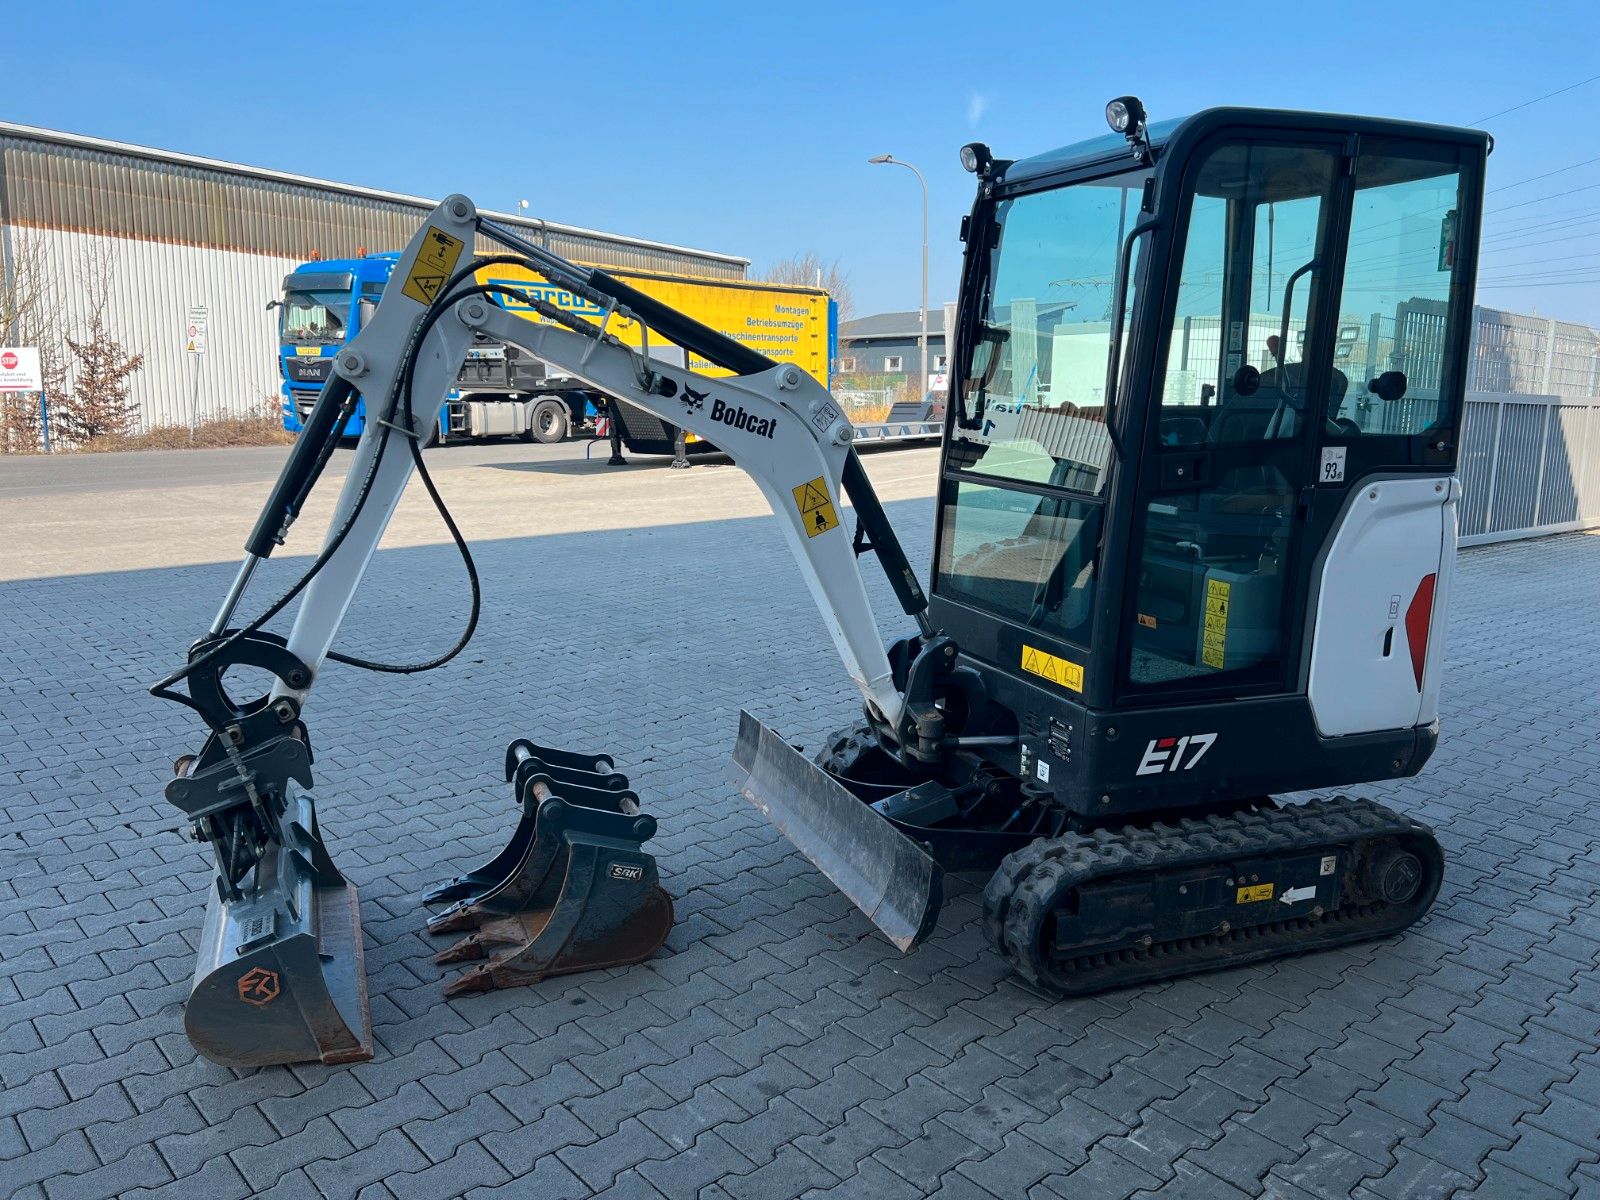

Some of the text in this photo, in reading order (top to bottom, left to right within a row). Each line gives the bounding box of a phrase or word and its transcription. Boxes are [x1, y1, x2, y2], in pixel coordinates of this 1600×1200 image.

[775, 304, 809, 316] Montagen
[746, 317, 804, 330] Betriebsumzüge
[711, 398, 777, 440] Bobcat
[1325, 463, 1337, 479] 93
[1136, 733, 1218, 776] E17
